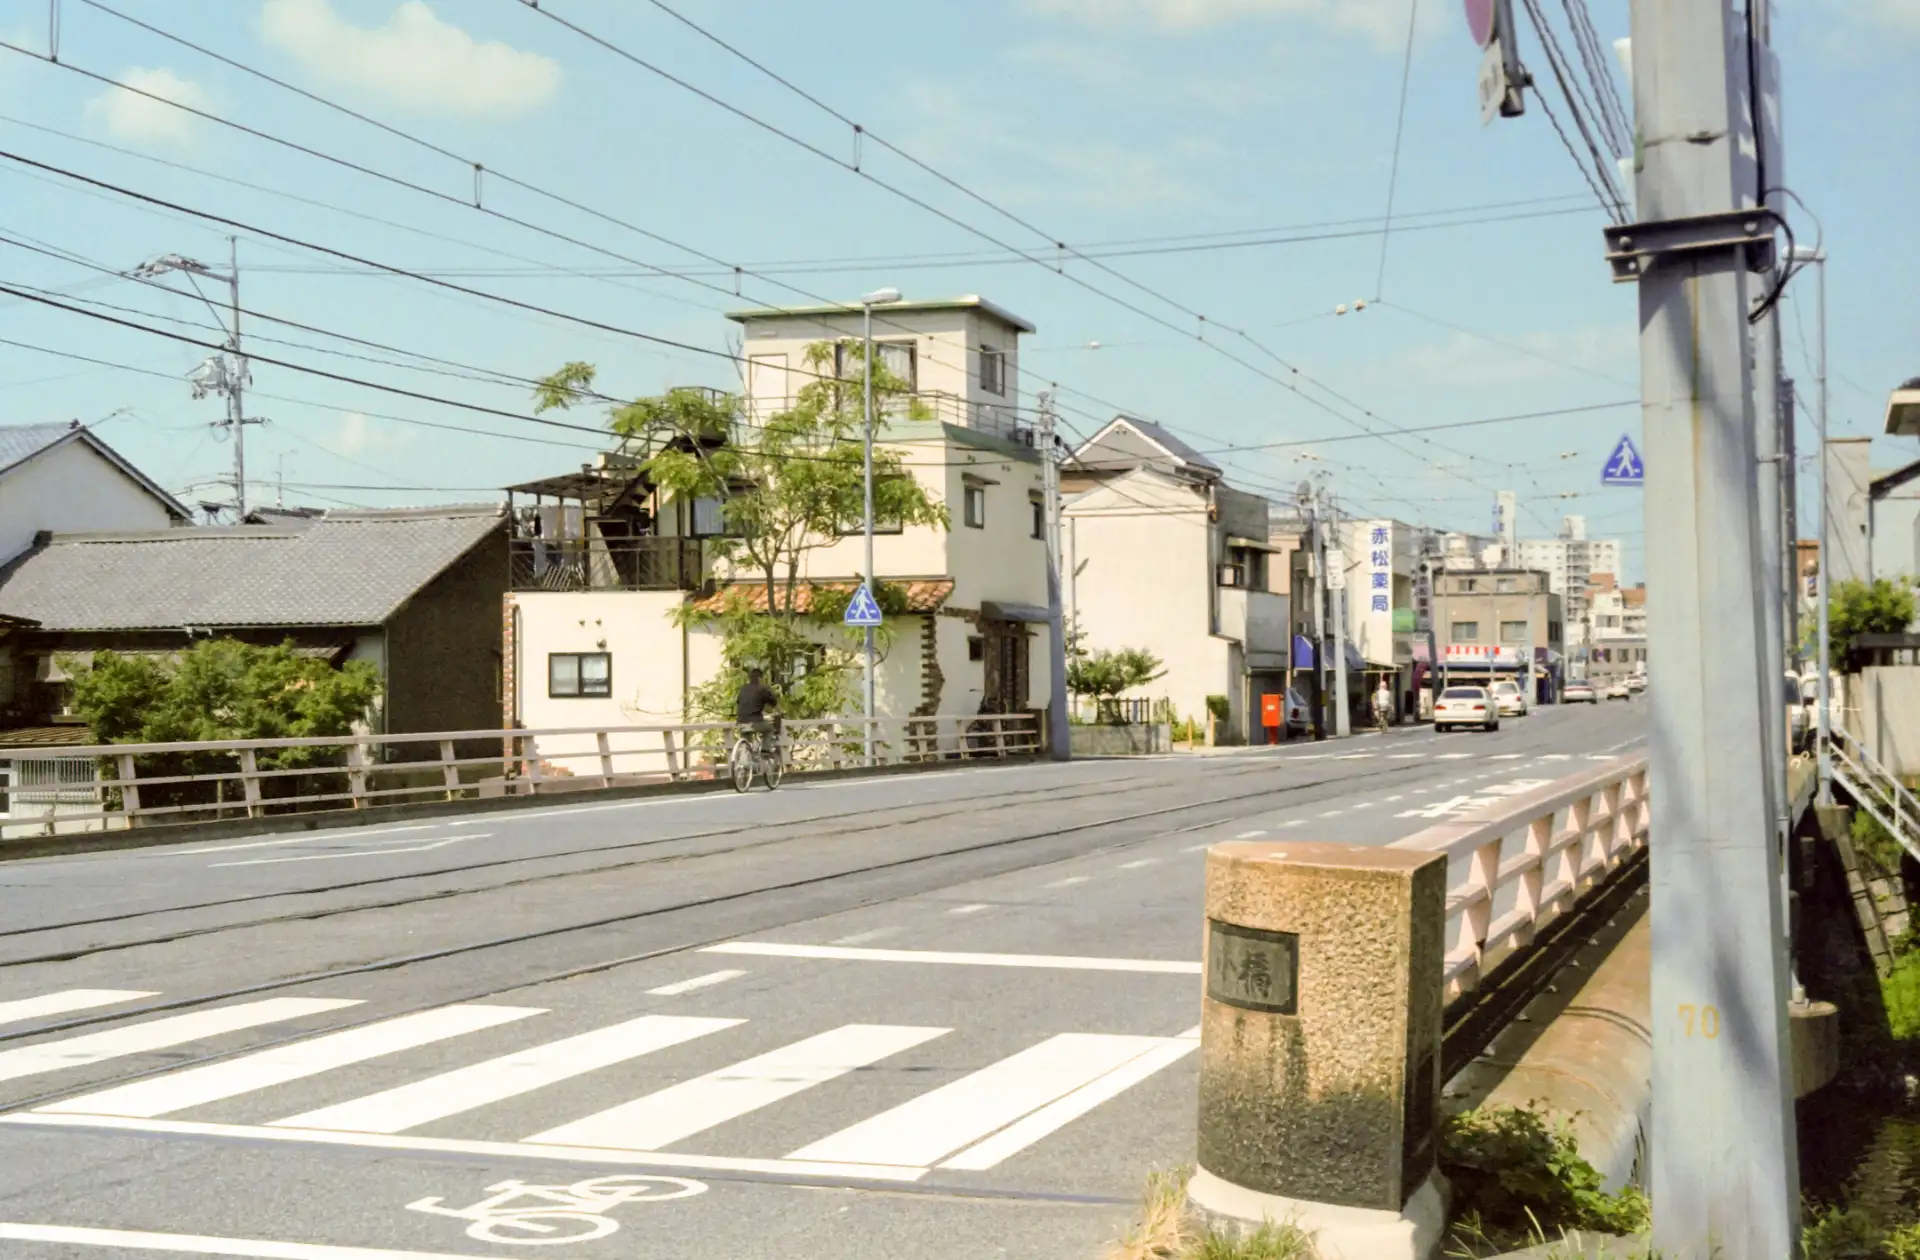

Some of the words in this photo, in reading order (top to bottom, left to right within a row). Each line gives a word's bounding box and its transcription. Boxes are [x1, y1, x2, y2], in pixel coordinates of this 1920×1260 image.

[1371, 527, 1389, 612] 赤松薬局
[1677, 1003, 1720, 1040] 70
